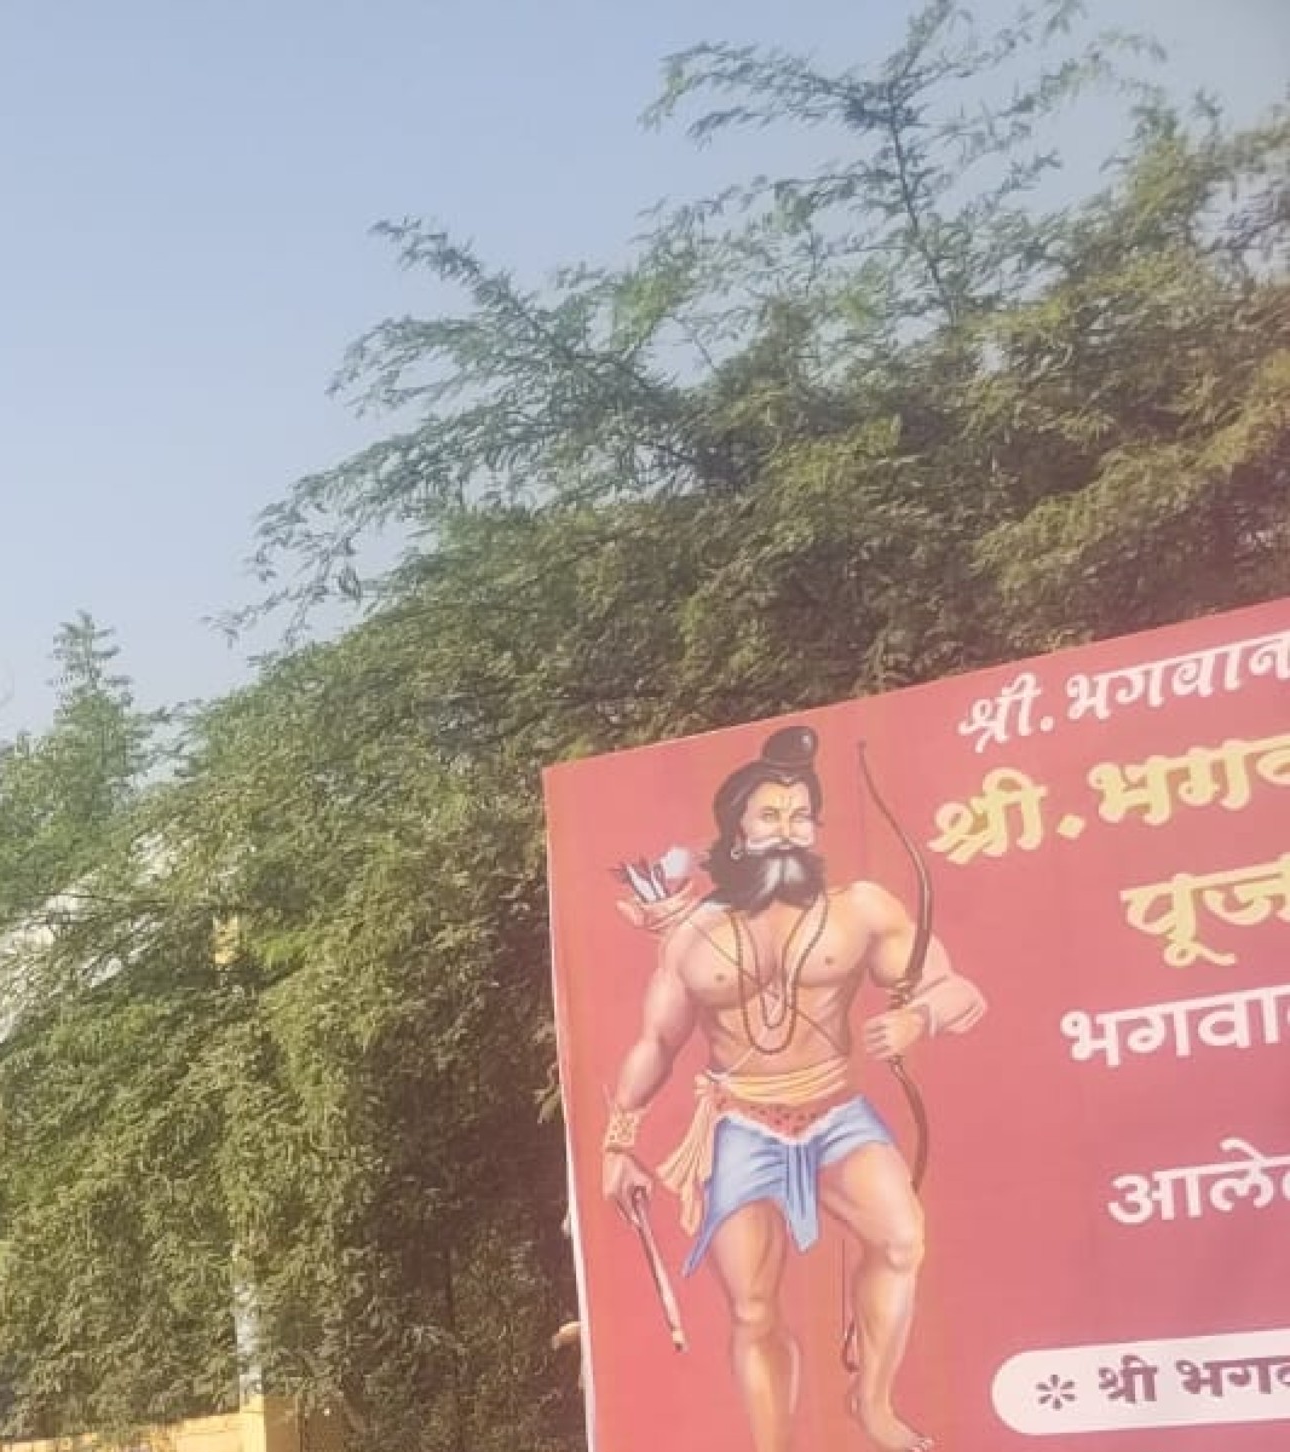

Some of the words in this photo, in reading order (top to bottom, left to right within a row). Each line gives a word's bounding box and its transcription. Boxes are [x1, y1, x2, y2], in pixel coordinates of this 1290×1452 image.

[1060, 984, 1290, 1067] भगवा
[1107, 1137, 1290, 1225] आले
[1098, 1354, 1159, 1404] श्री
